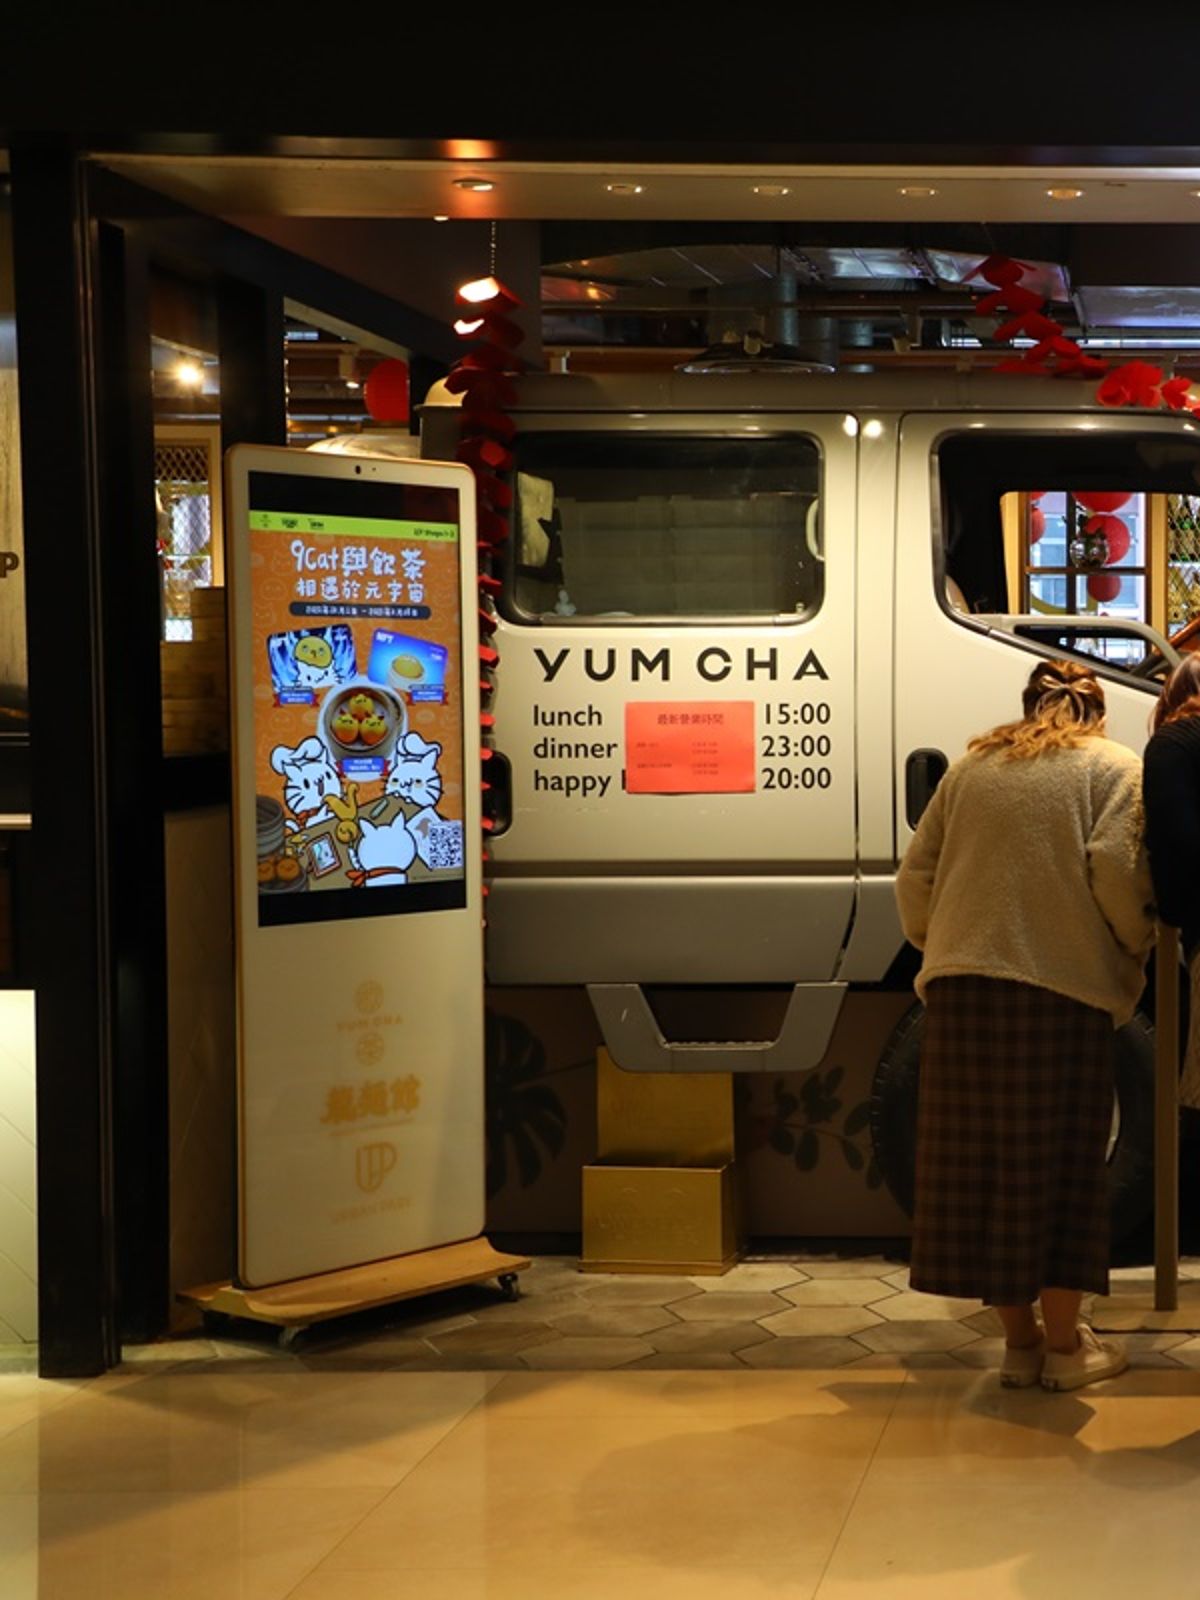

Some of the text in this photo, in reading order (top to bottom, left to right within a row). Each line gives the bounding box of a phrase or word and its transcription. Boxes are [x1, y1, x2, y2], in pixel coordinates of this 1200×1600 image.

[295, 576, 424, 603] 相遇於元宇宙
[533, 647, 829, 682] YUM CHA
[533, 703, 831, 726] lunch 15:00
[533, 735, 831, 758] dinner 23:00
[533, 769, 611, 797] happy
[762, 767, 831, 790] 20:00
